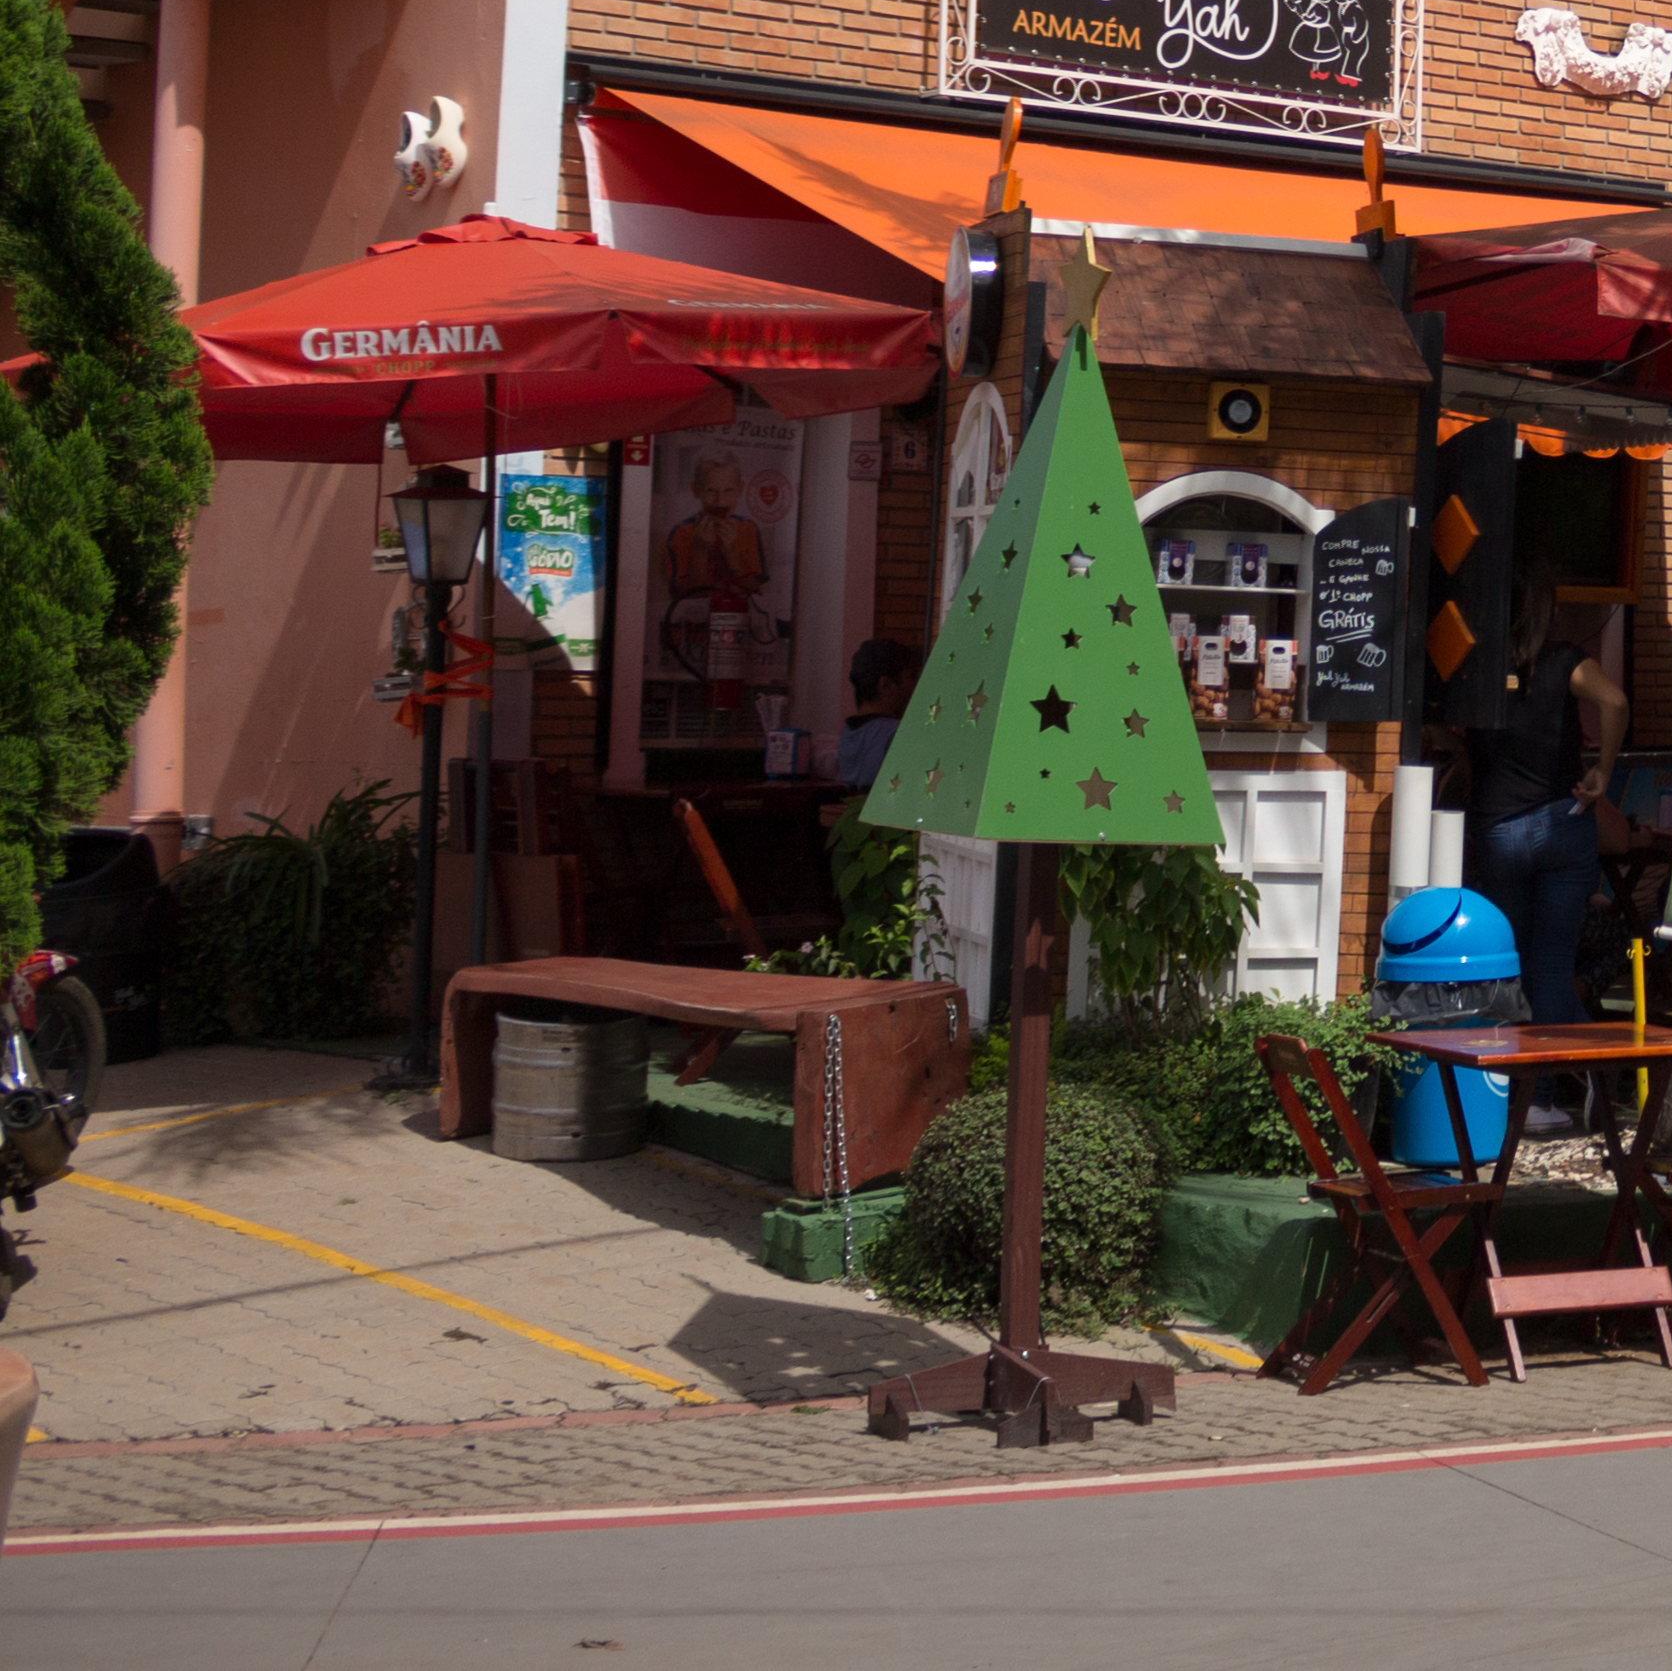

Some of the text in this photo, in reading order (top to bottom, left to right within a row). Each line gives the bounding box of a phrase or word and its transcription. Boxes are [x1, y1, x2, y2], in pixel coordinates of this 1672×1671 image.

[1012, 9, 1141, 51] ARMAZÉM
[300, 320, 503, 362] GERMÂNIA
[375, 359, 436, 375] CHOPP
[538, 506, 577, 531] Tem!
[1322, 539, 1390, 554] COMPRE NOSSA
[1328, 558, 1364, 568] CANECA
[1339, 574, 1370, 585] GANHE
[1342, 592, 1373, 603] CHOPP
[1318, 607, 1376, 630] GRÁTIS
